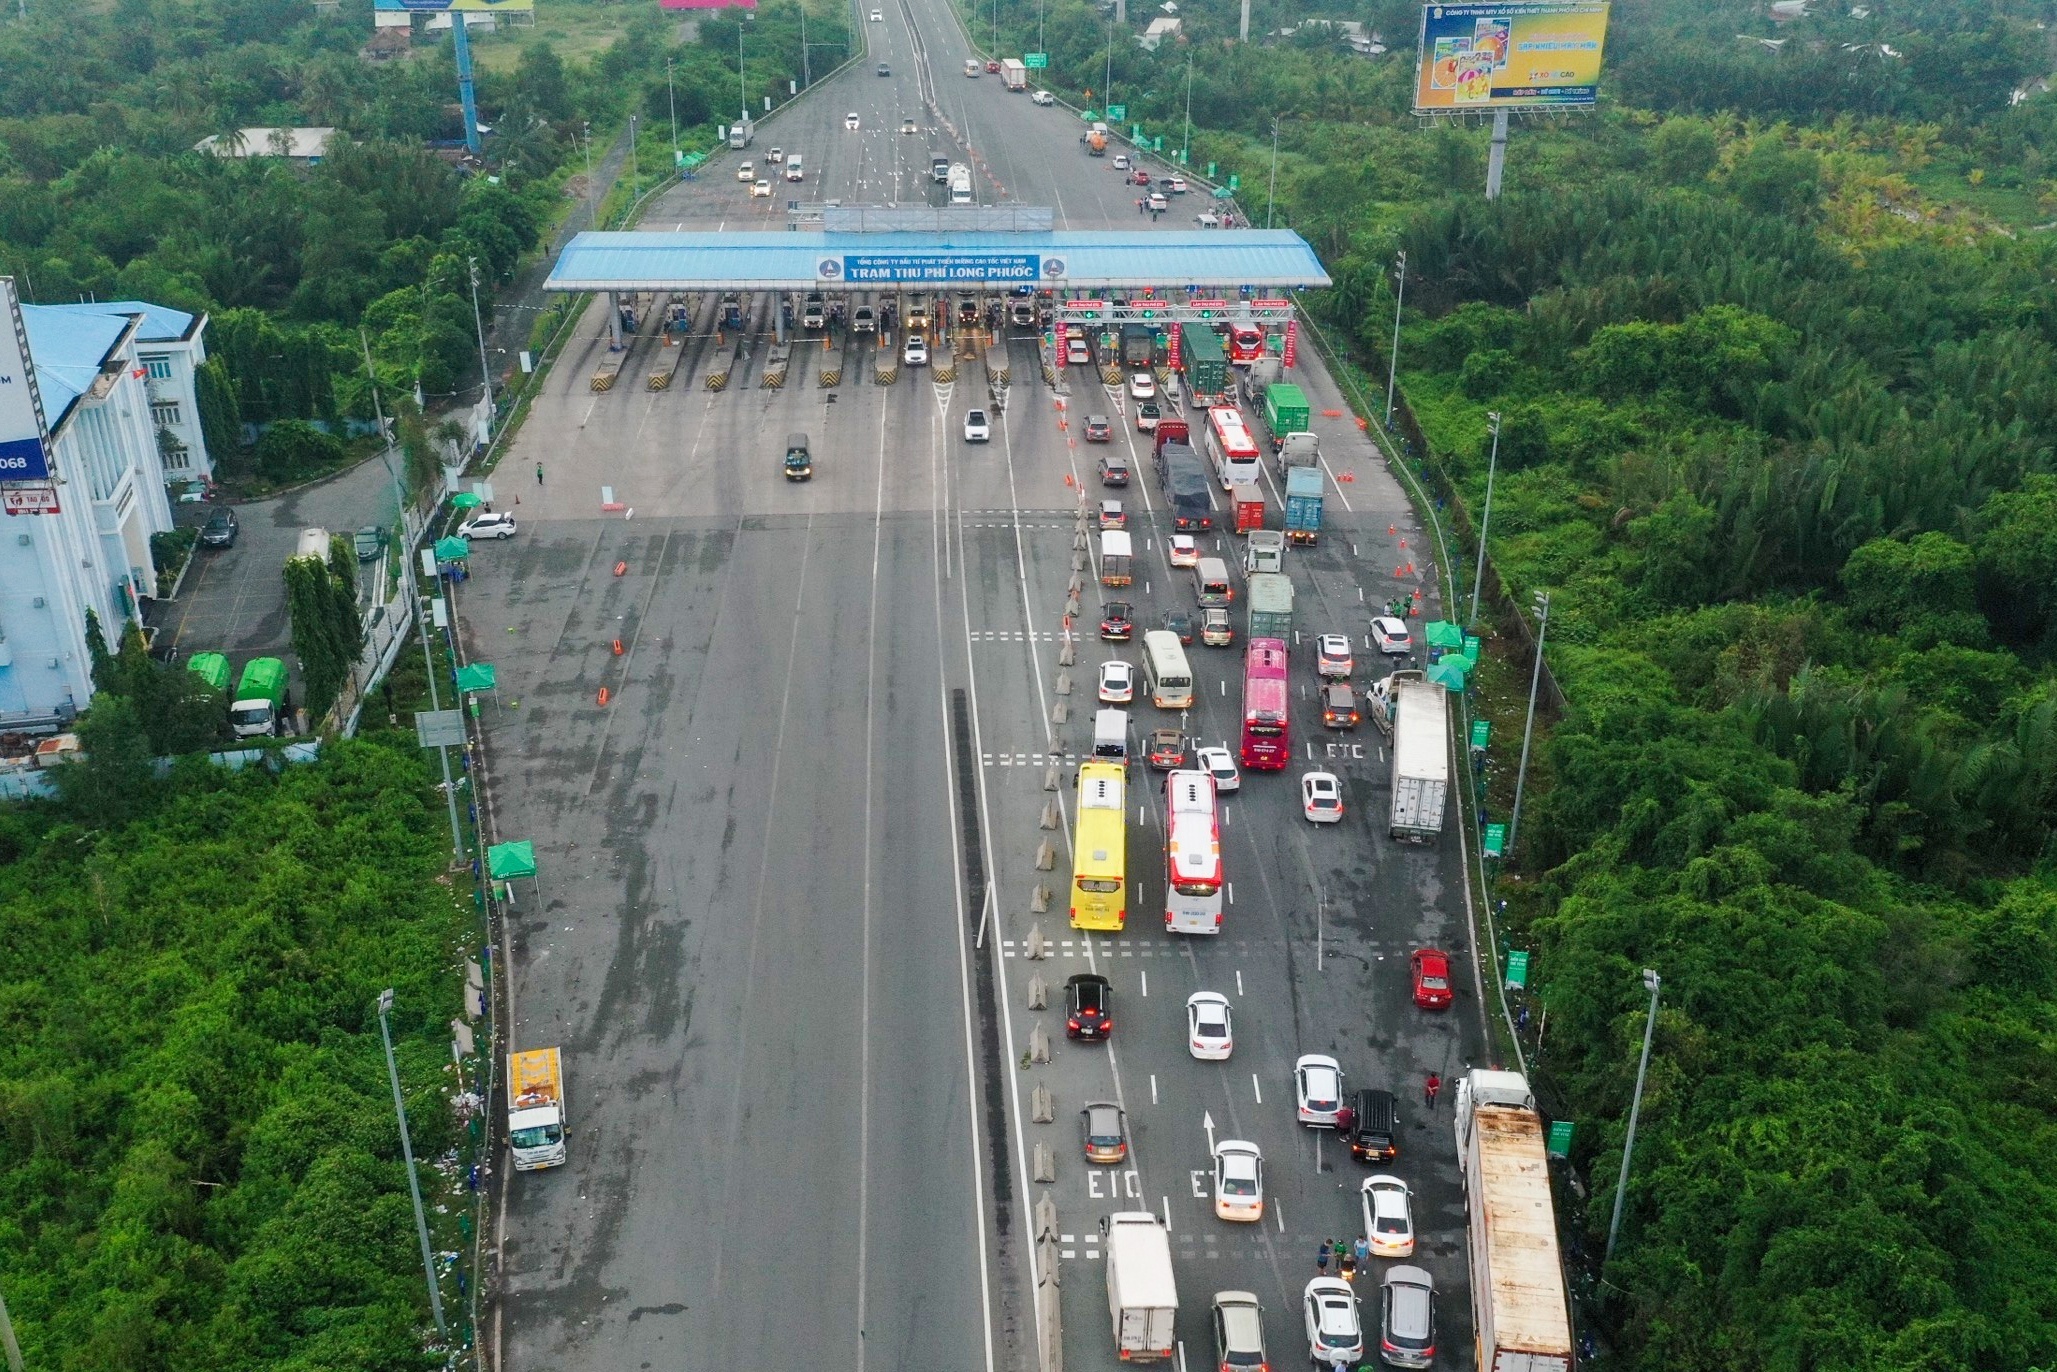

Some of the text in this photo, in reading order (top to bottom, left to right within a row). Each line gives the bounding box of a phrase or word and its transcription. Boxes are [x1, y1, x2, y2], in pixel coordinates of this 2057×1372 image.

[857, 257, 872, 265] TỔNG
[851, 265, 1033, 280] TRẠM THU PHÍ LONG PHƯỚC
[1326, 744, 1363, 758] ETC
[1088, 1170, 1140, 1198] ETC
